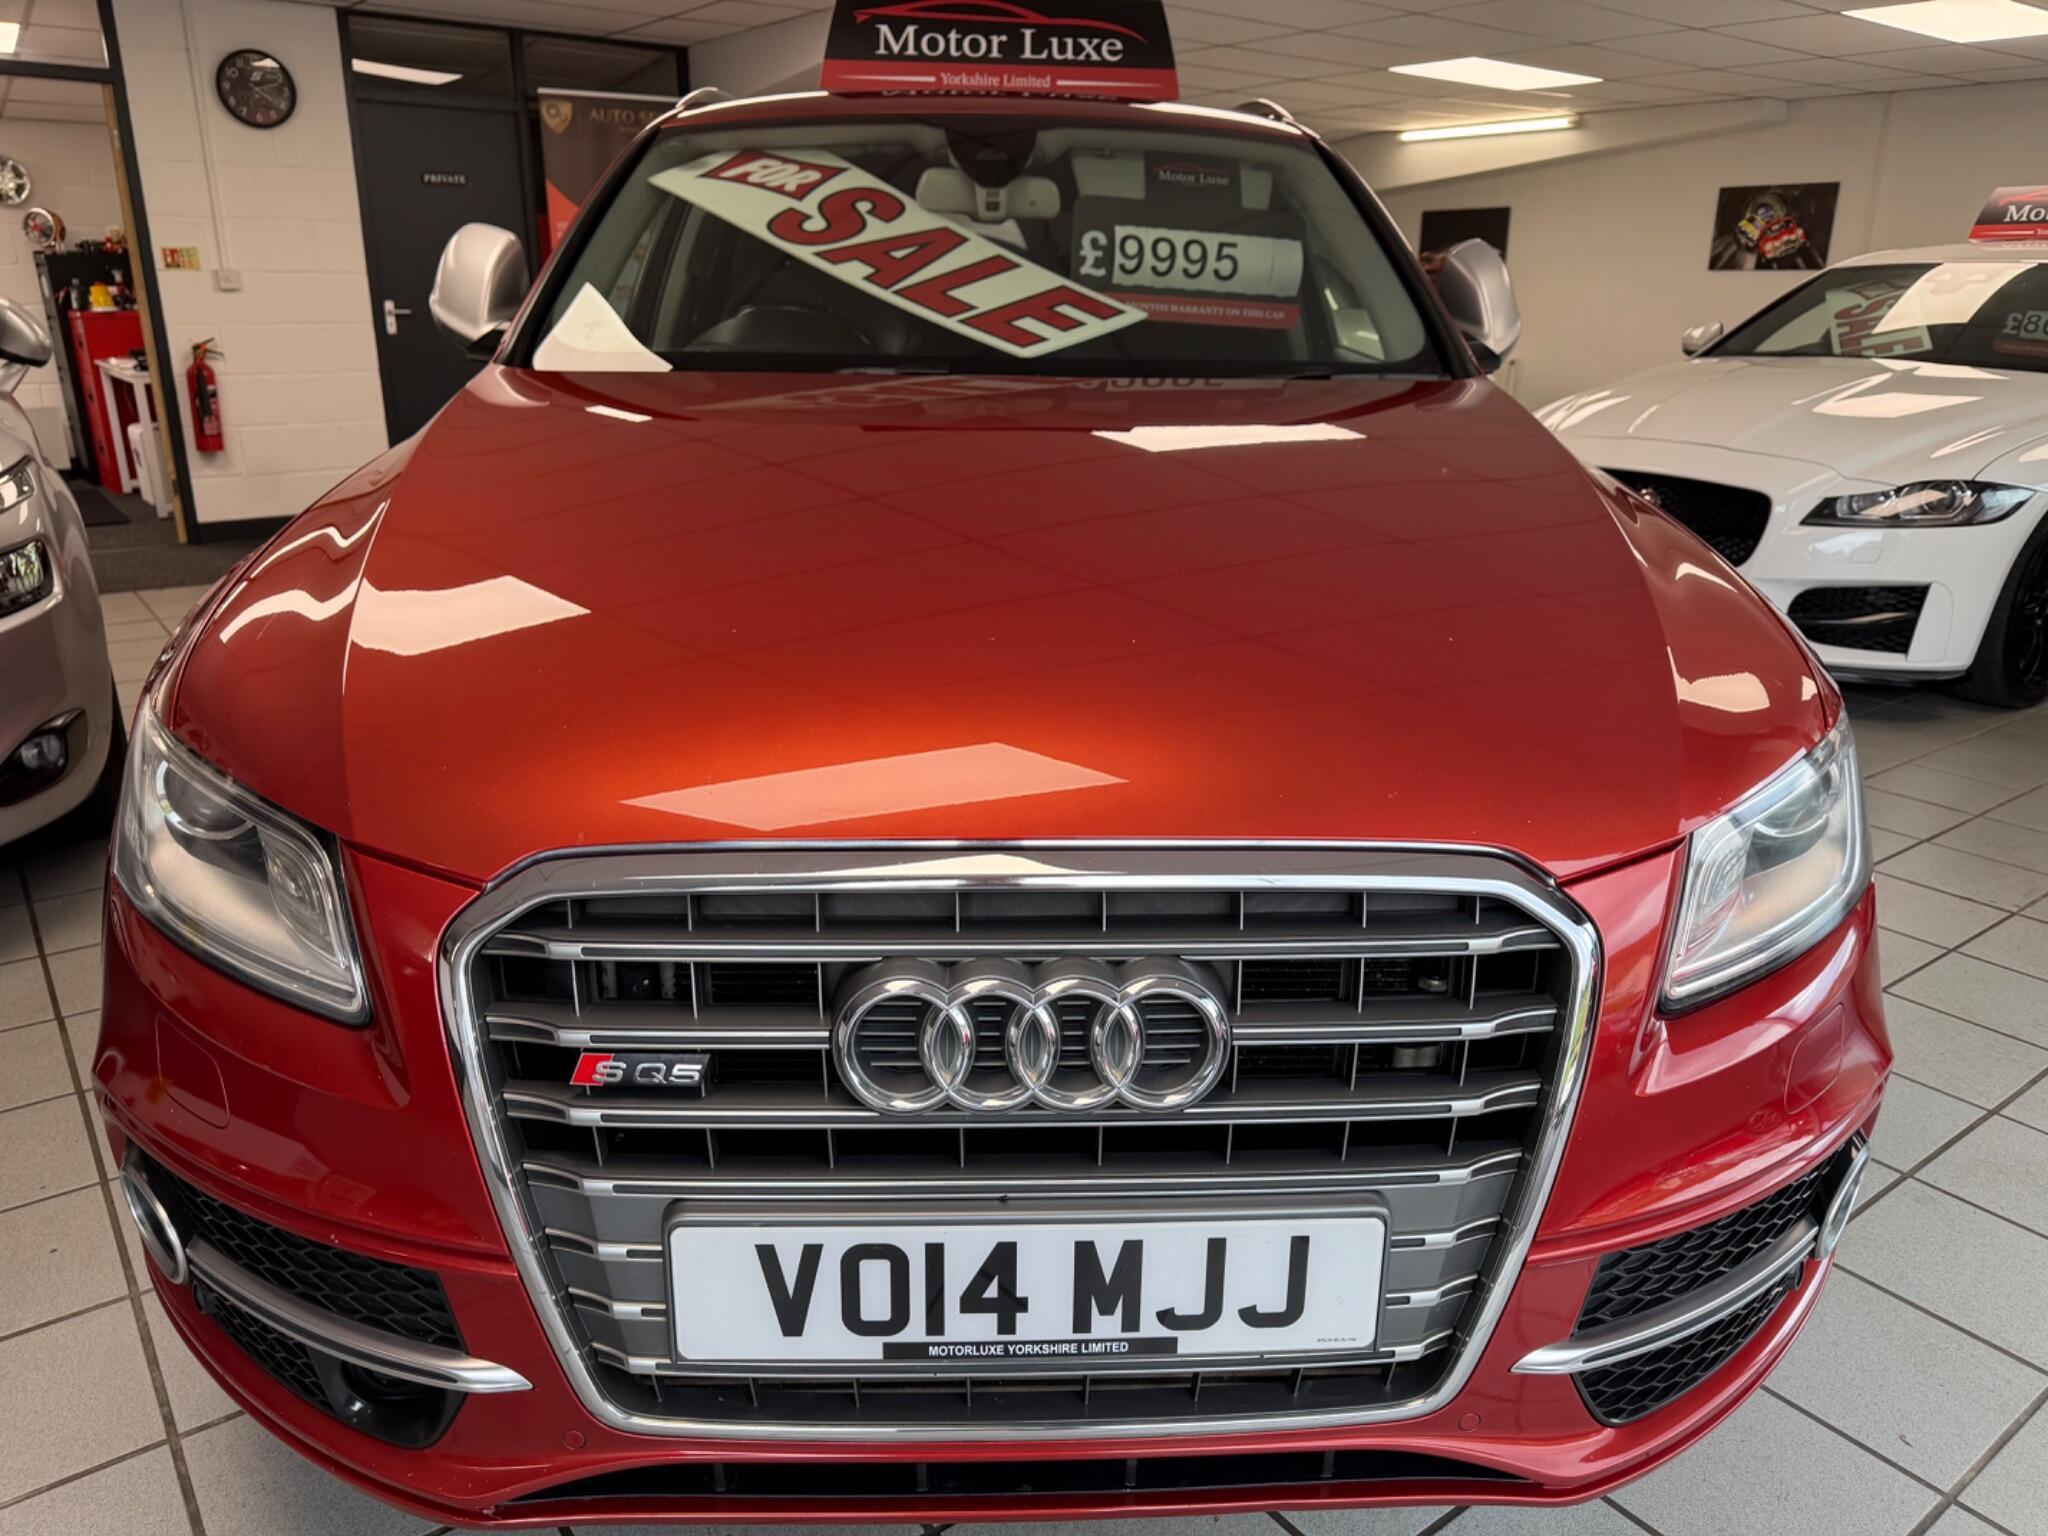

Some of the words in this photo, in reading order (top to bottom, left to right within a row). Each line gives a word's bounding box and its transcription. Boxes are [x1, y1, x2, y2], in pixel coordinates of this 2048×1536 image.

[874, 23, 1008, 58] Motor
[1020, 27, 1124, 63] Luxe
[940, 71, 1001, 88] Yorkshire
[1003, 72, 1051, 89] Limited
[590, 107, 635, 124] AUTO
[423, 173, 467, 184] PRIVATE
[718, 156, 823, 193] FOR
[1158, 169, 1196, 184] Motor
[1199, 172, 1230, 186] Luxe
[2003, 203, 2048, 222] Mo
[1079, 229, 1240, 281] £9995
[767, 187, 1126, 348] SALE
[1170, 303, 1224, 317] WARRANTY
[1264, 310, 1285, 320] CAR
[754, 1239, 1028, 1337] VO14
[1073, 1235, 1310, 1334] MJJ
[928, 1345, 1005, 1357] MOTORLUXE
[1006, 1343, 1079, 1356] YORKSHIRE
[1081, 1341, 1129, 1354] LIMITED
